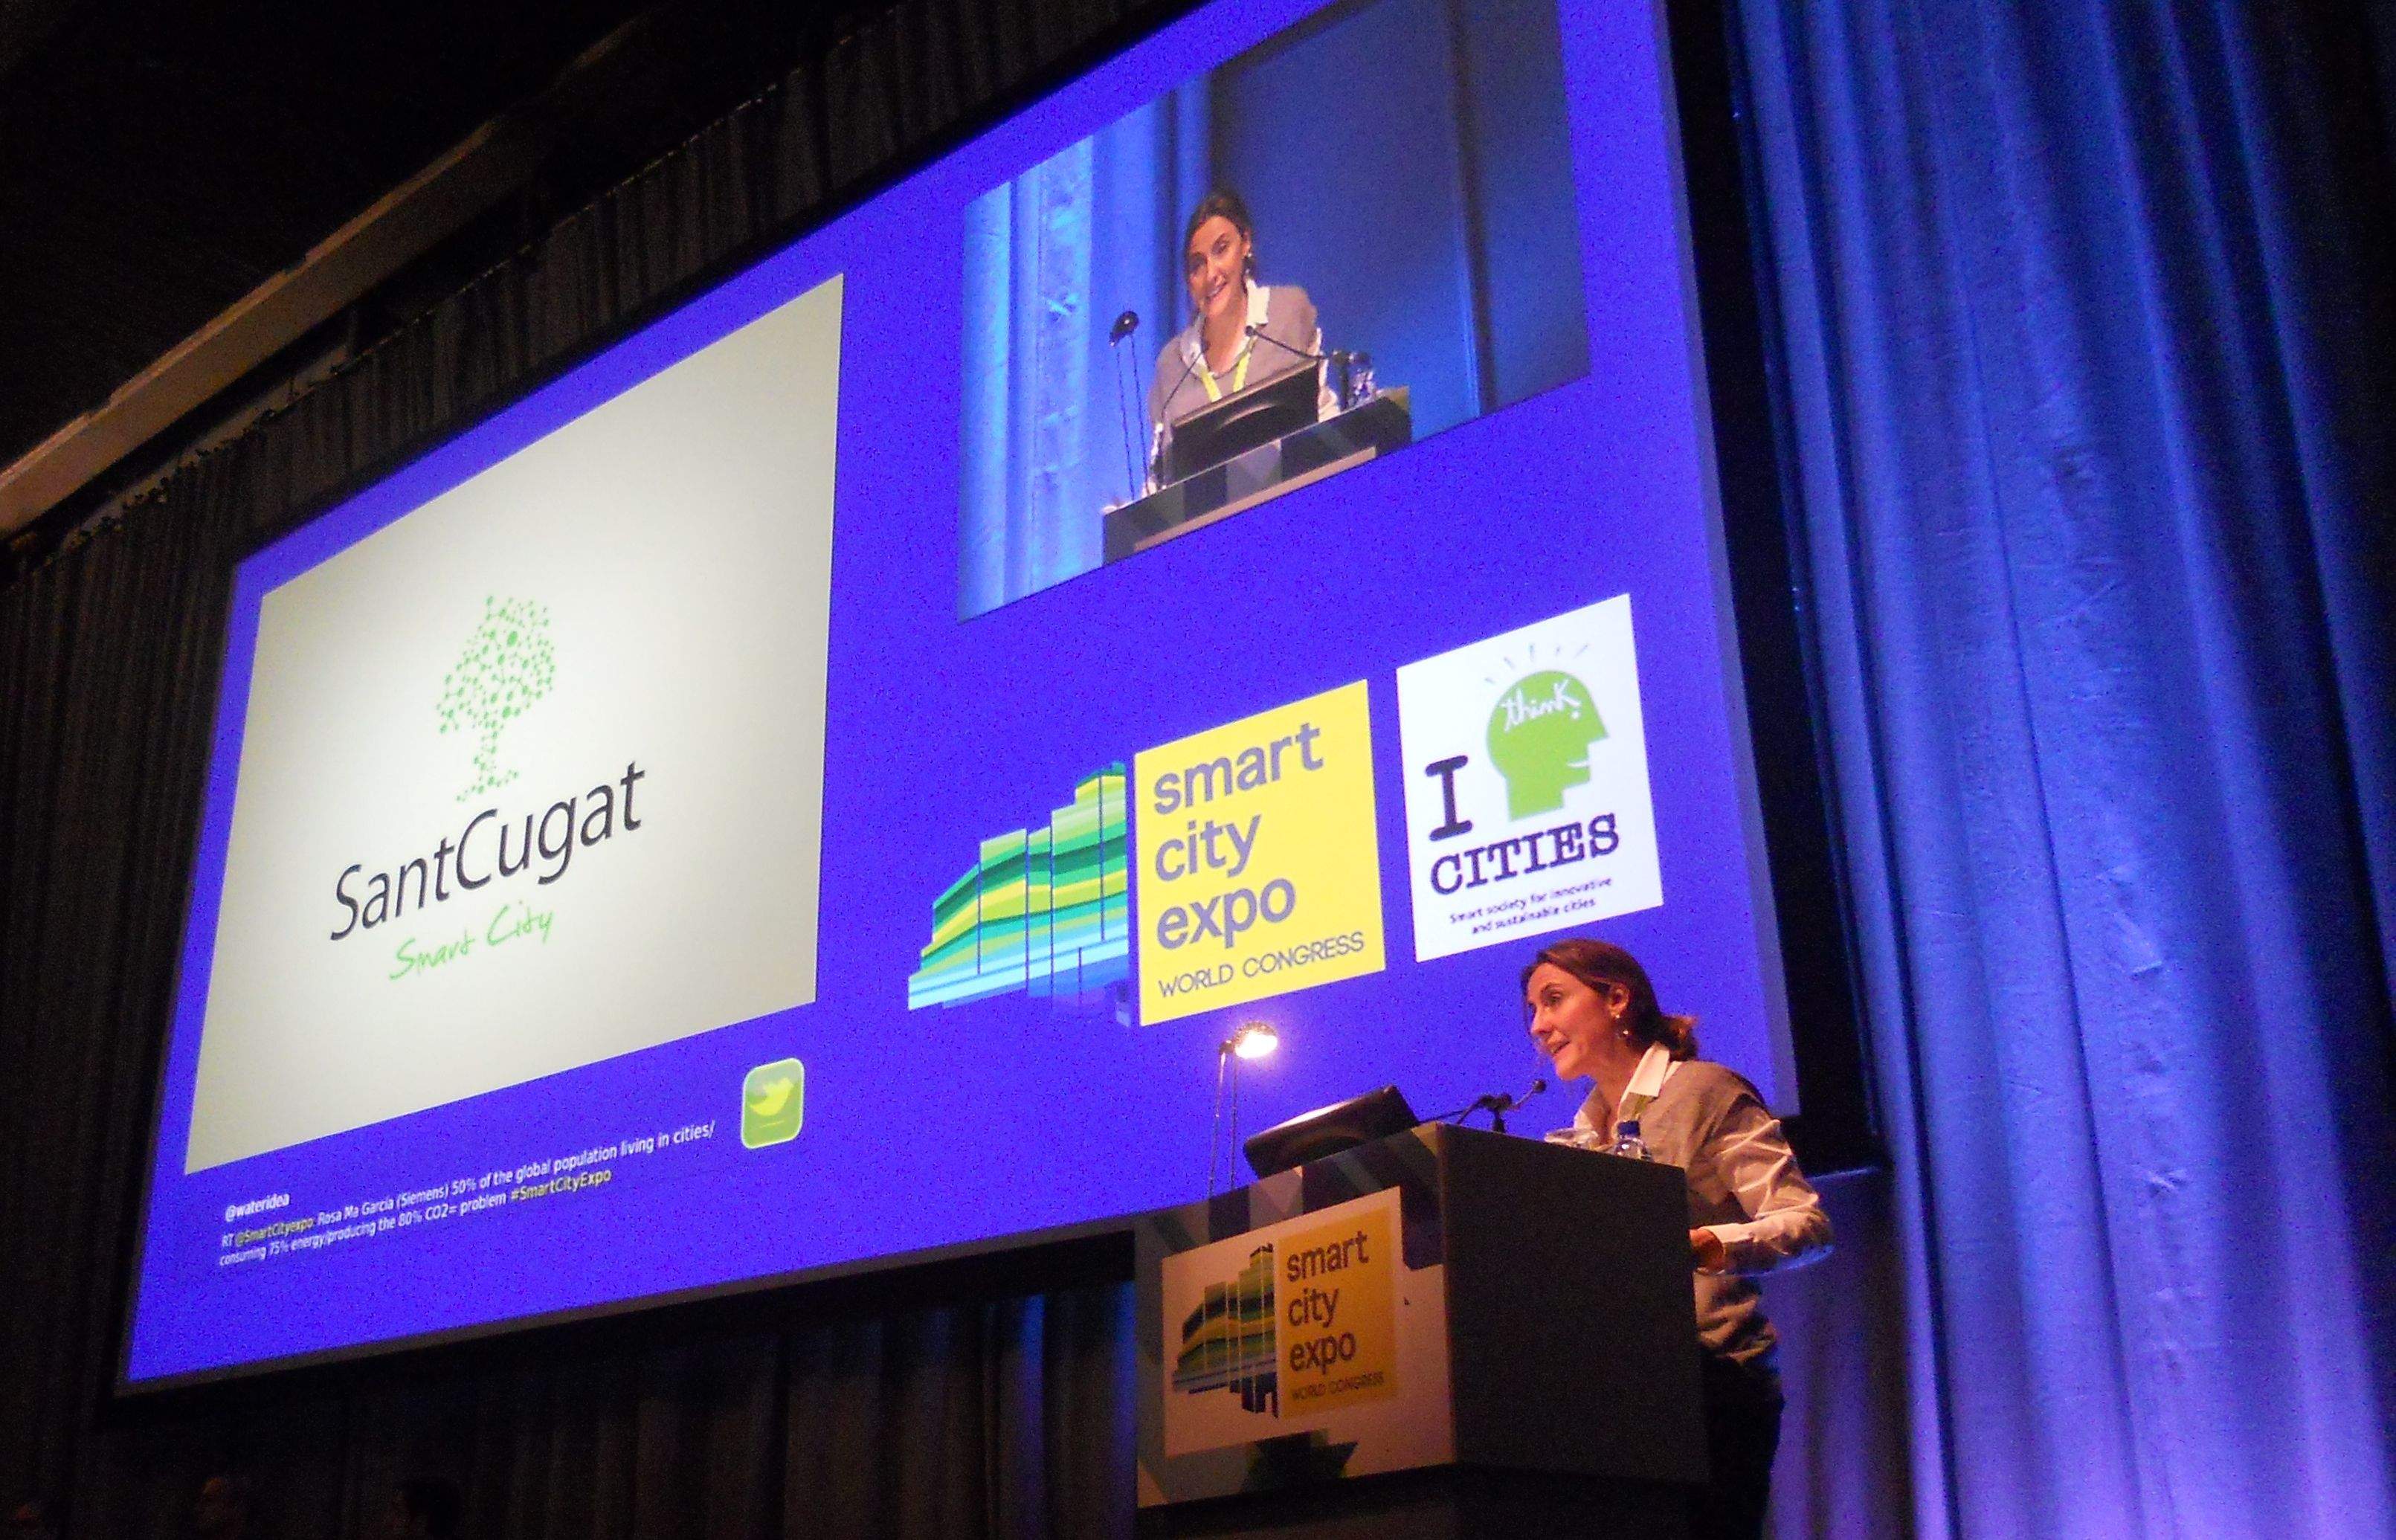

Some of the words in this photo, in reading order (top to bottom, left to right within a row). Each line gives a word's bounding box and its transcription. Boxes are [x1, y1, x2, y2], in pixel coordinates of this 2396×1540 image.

[1153, 722, 1324, 815] smart
[1425, 755, 1473, 842] I
[329, 760, 645, 941] SantCugat
[1155, 814, 1262, 882] city
[1429, 812, 1620, 895] CITIES
[389, 930, 476, 982] Smart
[486, 901, 555, 945] City
[1156, 877, 1296, 950] expo
[1450, 909, 1484, 924] Smart
[1486, 898, 1527, 915] society
[1530, 892, 1548, 903] for
[1472, 921, 1492, 935] and
[1563, 898, 1596, 913] cities
[1158, 964, 1234, 998] WORLD
[1242, 931, 1365, 978] CONGRESS
[222, 1234, 234, 1247] RT
[318, 1211, 342, 1225] Rosa
[396, 1183, 449, 1209] (Siemens)
[452, 1177, 477, 1196] 50%
[480, 1172, 492, 1189] of
[493, 1170, 513, 1186] the
[516, 1159, 551, 1184] global
[553, 1146, 618, 1174] population
[620, 1137, 654, 1157] living
[657, 1132, 670, 1149] in
[673, 1119, 715, 1144] cities/
[378, 1217, 396, 1231] the
[460, 1192, 507, 1216] problem
[510, 1169, 612, 1202] #SmartCityExpo
[1286, 1230, 1370, 1283] smart
[1287, 1287, 1339, 1328] city
[1288, 1332, 1357, 1375] expo
[1292, 1382, 1325, 1400] WORLD
